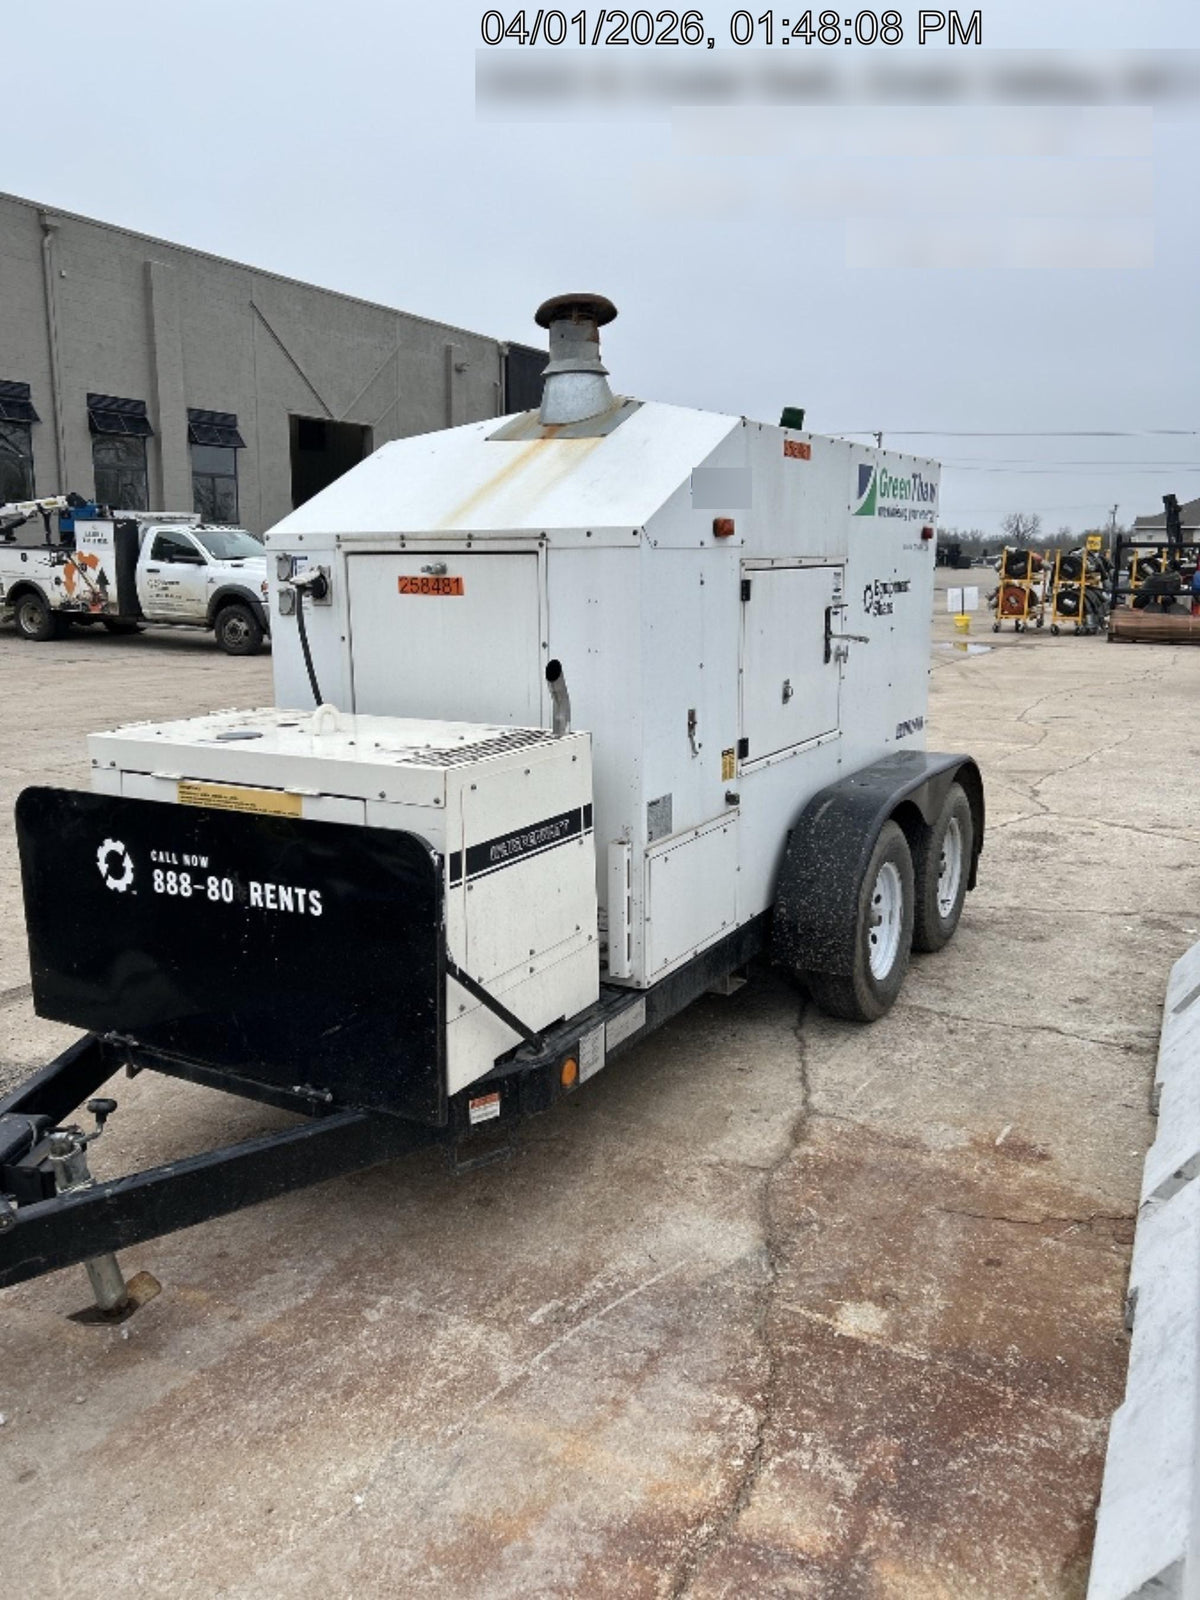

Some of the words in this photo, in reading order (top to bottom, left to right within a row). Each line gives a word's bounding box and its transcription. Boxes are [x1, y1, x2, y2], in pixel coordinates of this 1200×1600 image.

[399, 577, 461, 595] 258481
[150, 849, 179, 865] CALL
[182, 853, 209, 868] NOW
[153, 869, 234, 903] 888-80
[249, 881, 323, 917] RENTS
